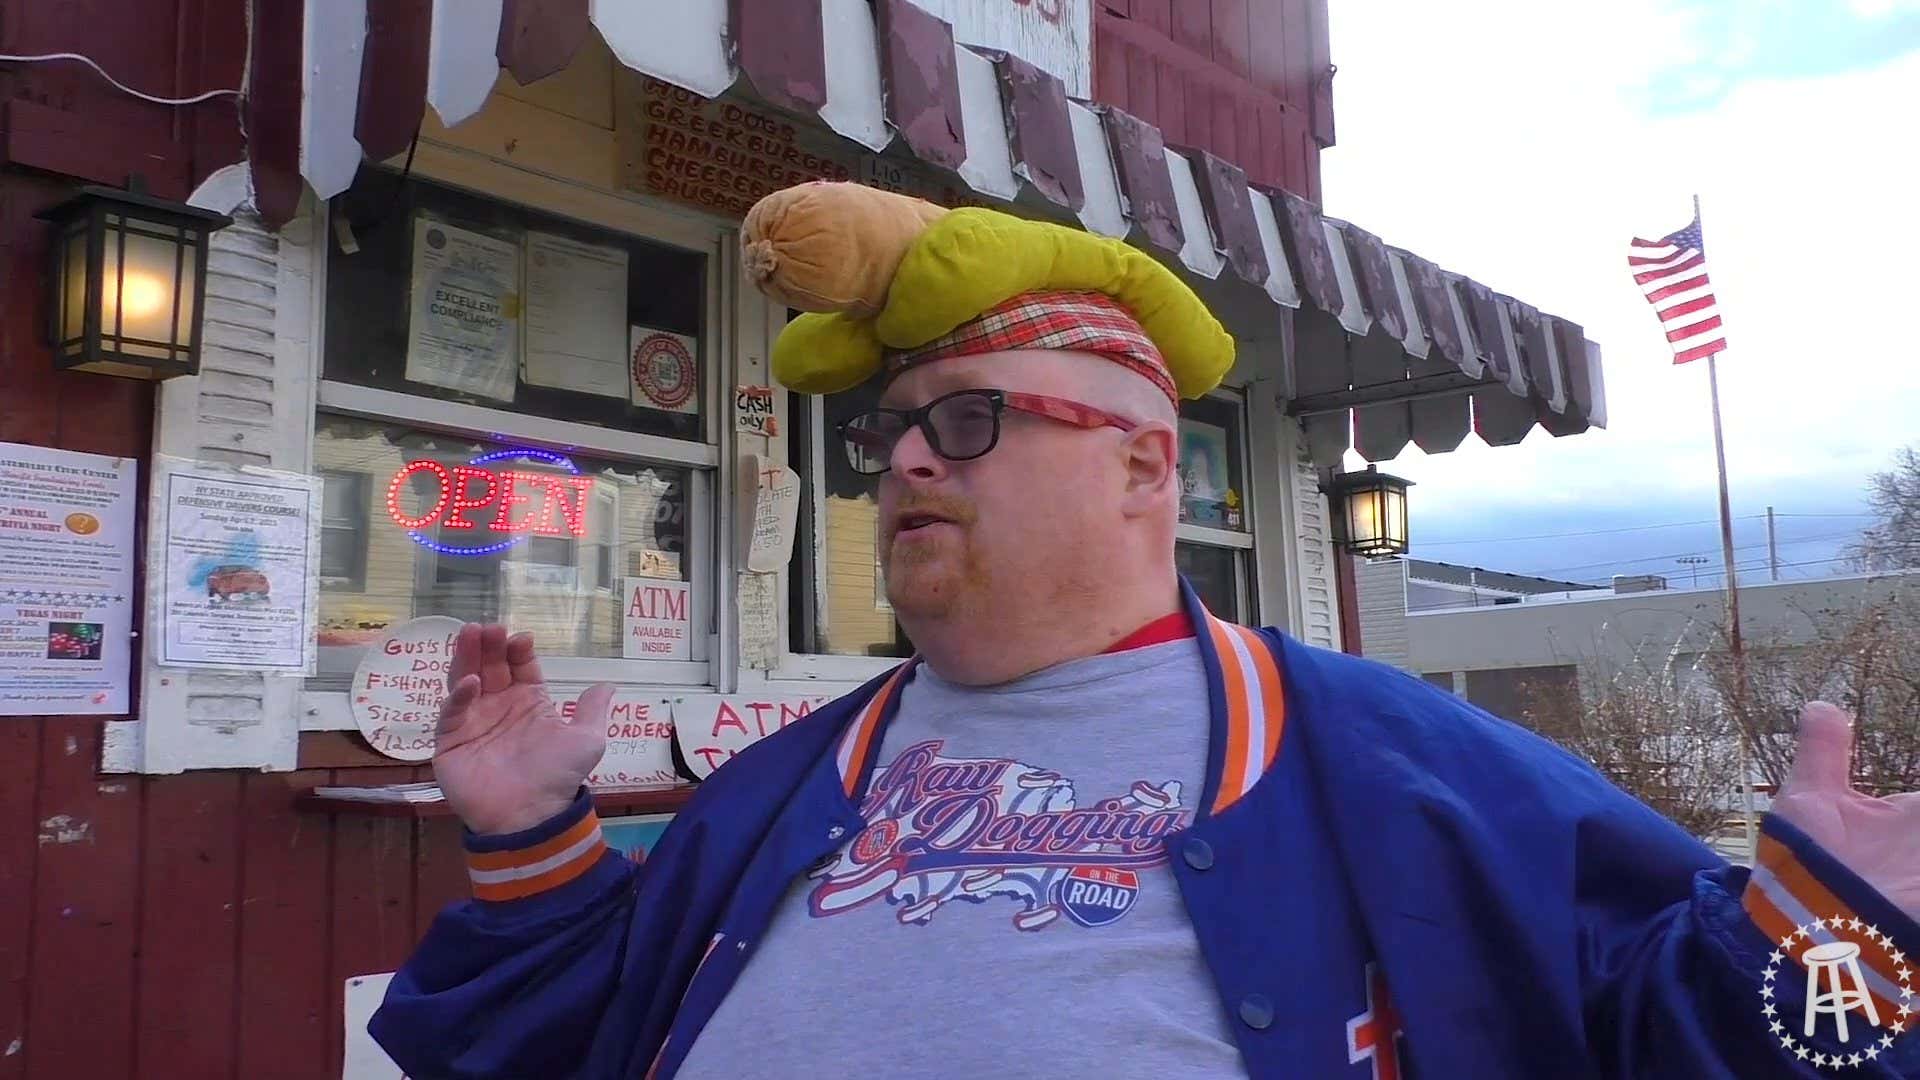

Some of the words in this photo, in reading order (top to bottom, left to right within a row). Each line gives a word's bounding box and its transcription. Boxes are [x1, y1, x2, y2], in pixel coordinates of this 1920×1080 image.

[646, 79, 706, 109] HOT
[724, 104, 797, 143] DOGS
[648, 100, 744, 146] GREEK
[648, 123, 818, 187] HAMBURGE
[435, 289, 500, 315] EXCELLENT
[430, 303, 504, 331] COMPLIANCE
[737, 393, 773, 414] CASH
[387, 459, 594, 536] OPEN
[16, 609, 49, 618] VEGAS
[51, 611, 84, 620] NIGHT
[626, 585, 688, 622] ATM
[632, 627, 682, 641] AVAILABLE
[641, 642, 672, 654] INSIDE
[607, 722, 674, 739] ORDERS
[711, 699, 812, 738] ATM
[861, 740, 1010, 818] Raw
[910, 784, 1184, 854] Dogging
[1104, 870, 1121, 883] THE
[1068, 881, 1130, 910] ROAD
